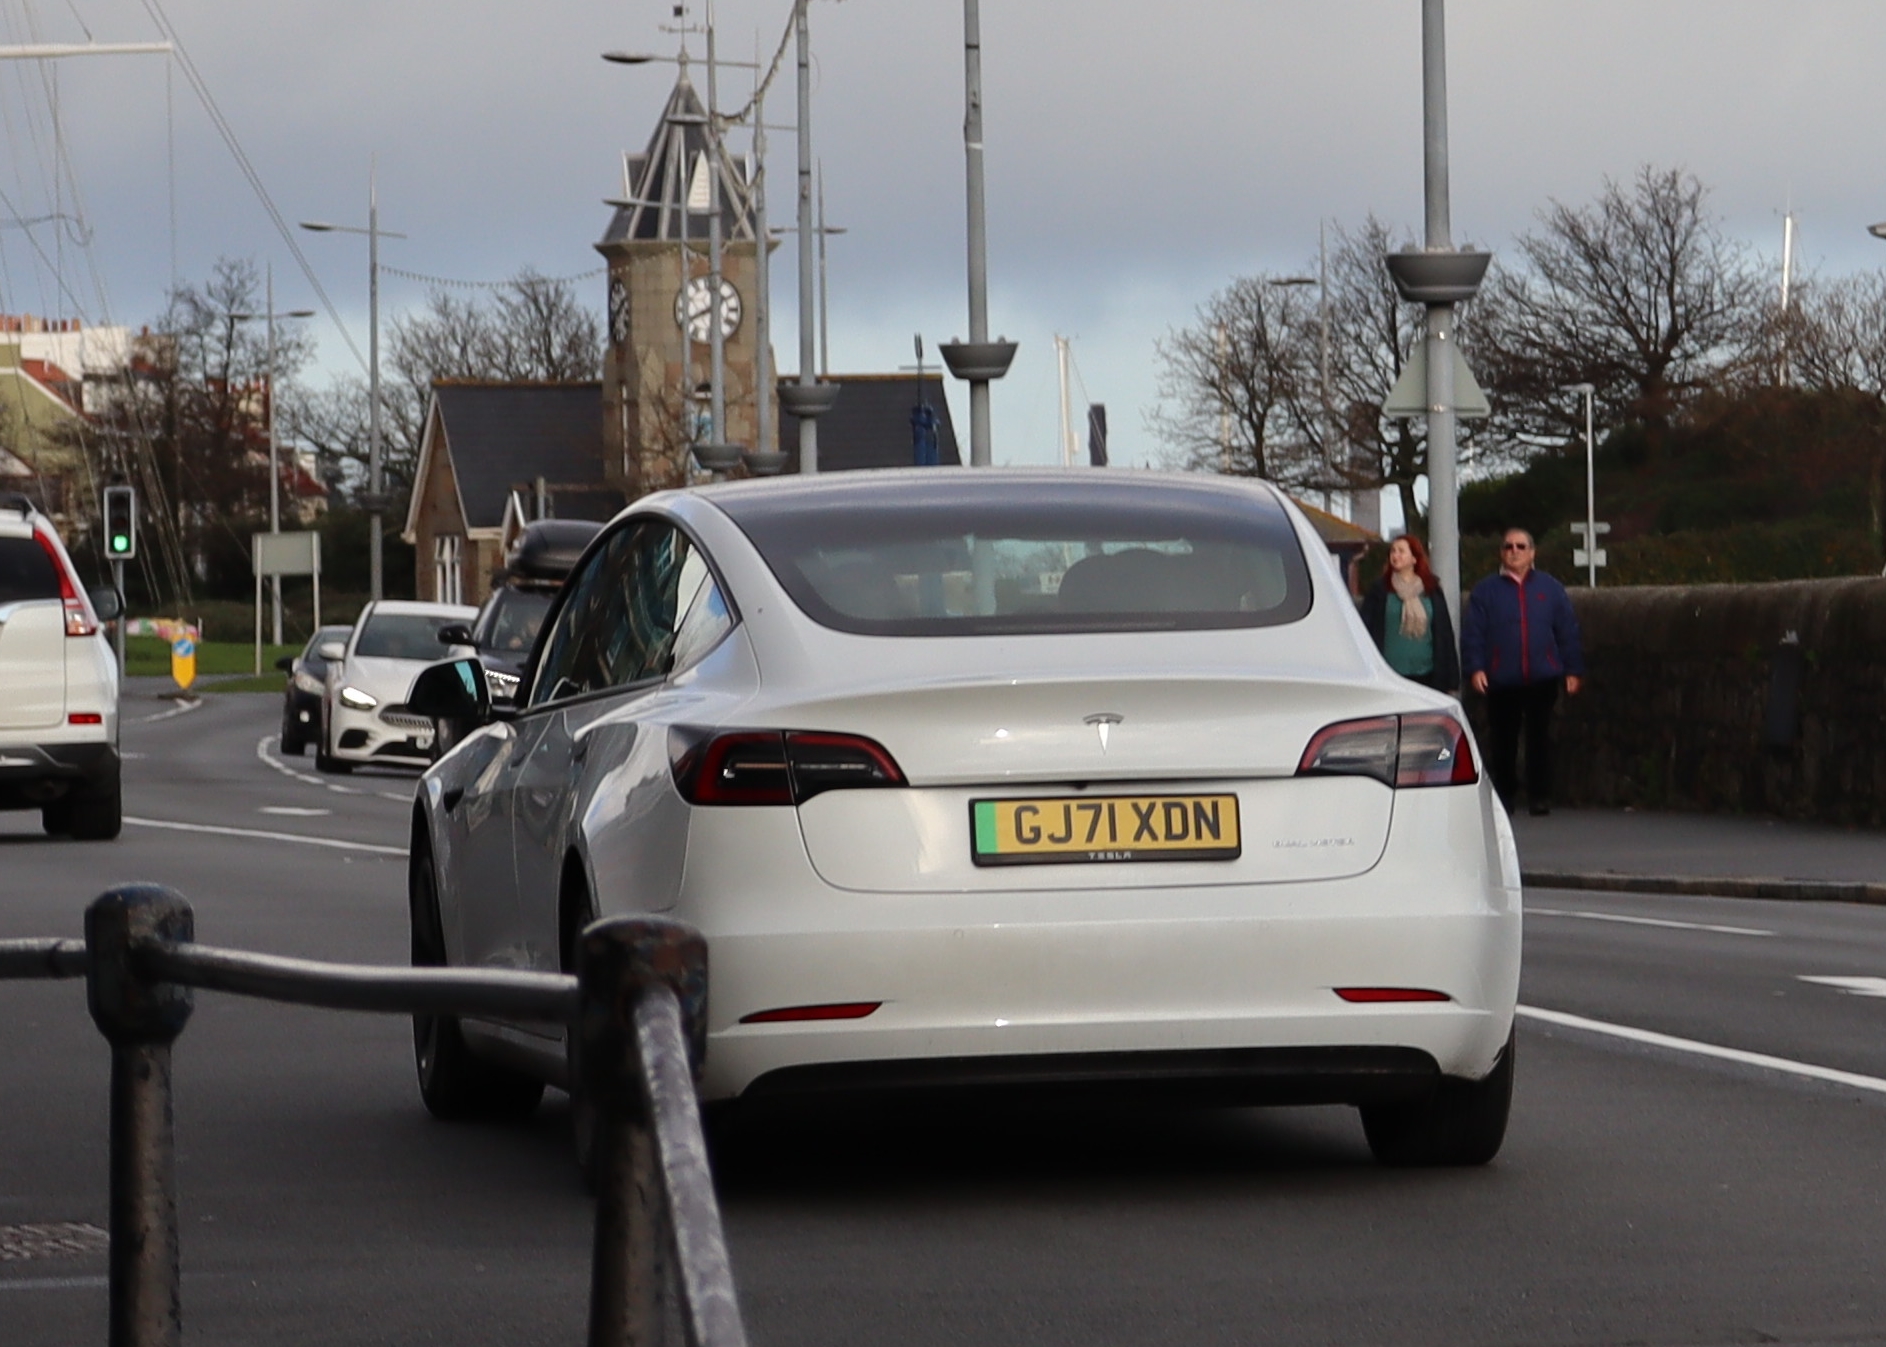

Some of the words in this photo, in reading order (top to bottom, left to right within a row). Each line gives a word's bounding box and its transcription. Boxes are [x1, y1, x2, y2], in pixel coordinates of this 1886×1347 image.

[1014, 803, 1117, 844] GJ71
[1131, 800, 1221, 841] XDN
[1088, 851, 1131, 860] TESLA
